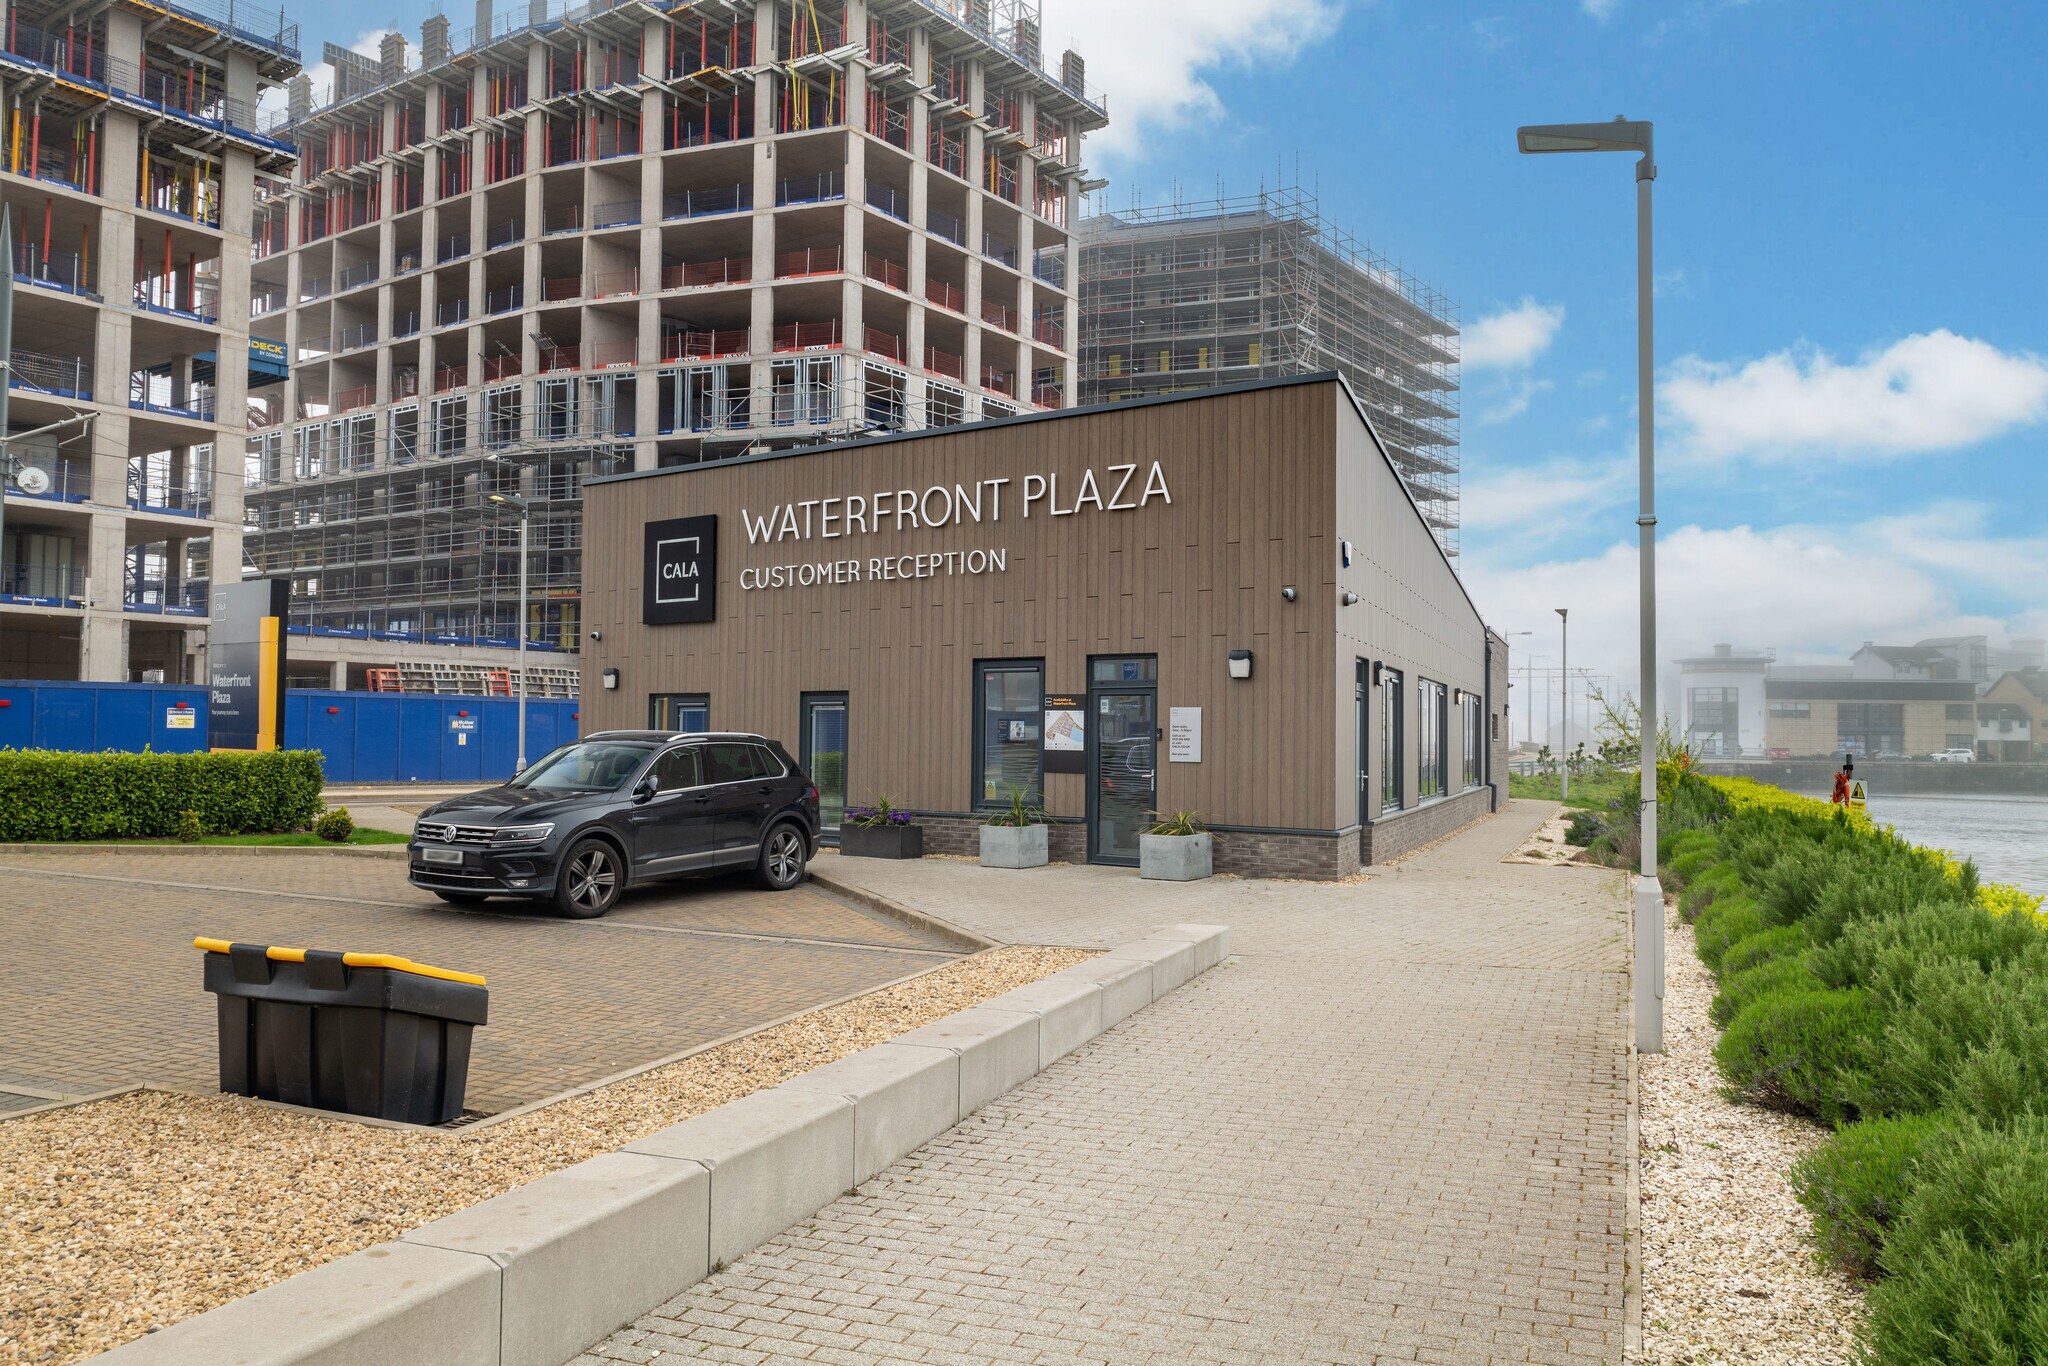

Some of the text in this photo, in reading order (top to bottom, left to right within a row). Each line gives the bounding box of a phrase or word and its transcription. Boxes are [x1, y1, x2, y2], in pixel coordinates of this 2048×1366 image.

[741, 461, 1172, 544] WATERFRONT PLAZA
[663, 561, 699, 579] CALA
[739, 548, 1006, 590] CUSTOMER RECEPTION
[216, 603, 226, 611] CALA
[212, 674, 252, 687] Waterfront
[212, 690, 231, 704] Plaza
